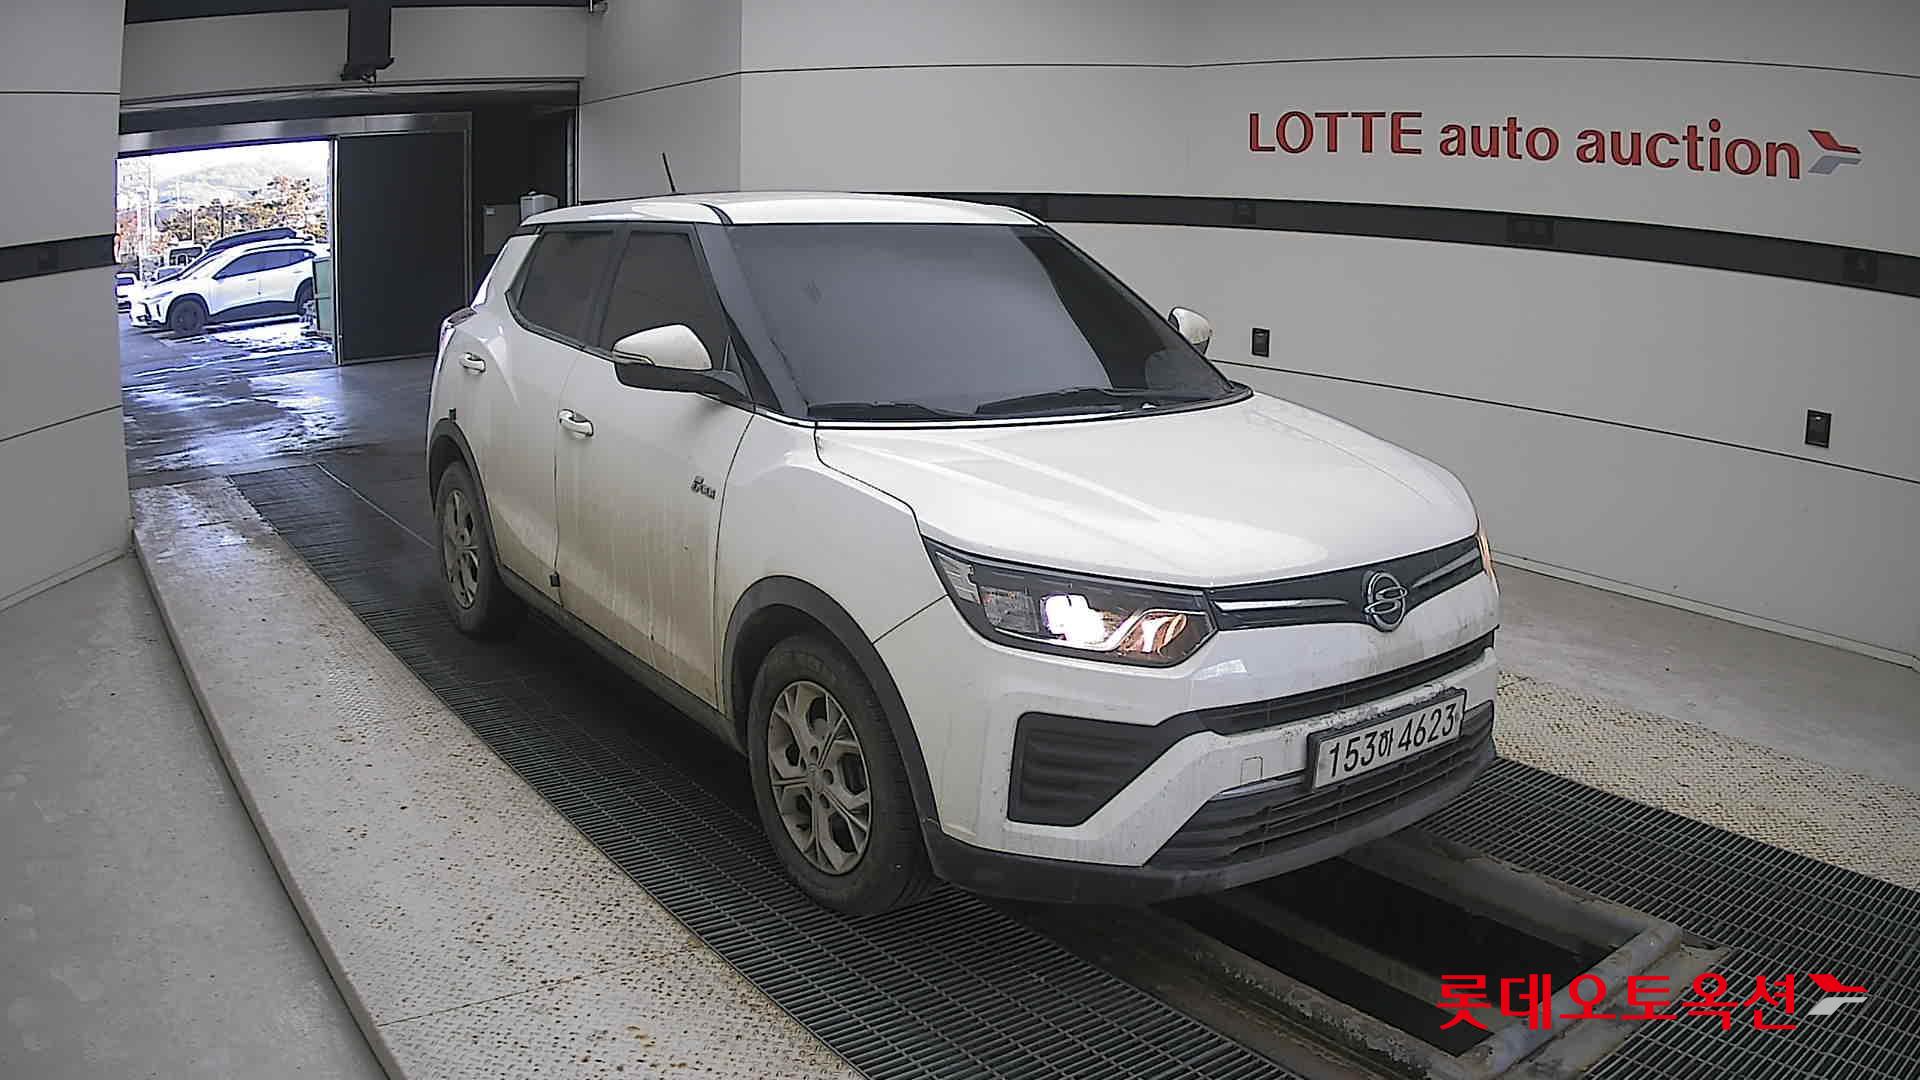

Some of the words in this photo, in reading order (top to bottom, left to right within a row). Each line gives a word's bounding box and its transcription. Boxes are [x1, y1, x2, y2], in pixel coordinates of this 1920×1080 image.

[1248, 111, 1424, 155] LOTTE
[1439, 117, 1559, 162] auto
[1576, 118, 1801, 179] auction
[1329, 727, 1394, 777] 153하
[1397, 702, 1457, 752] 4623
